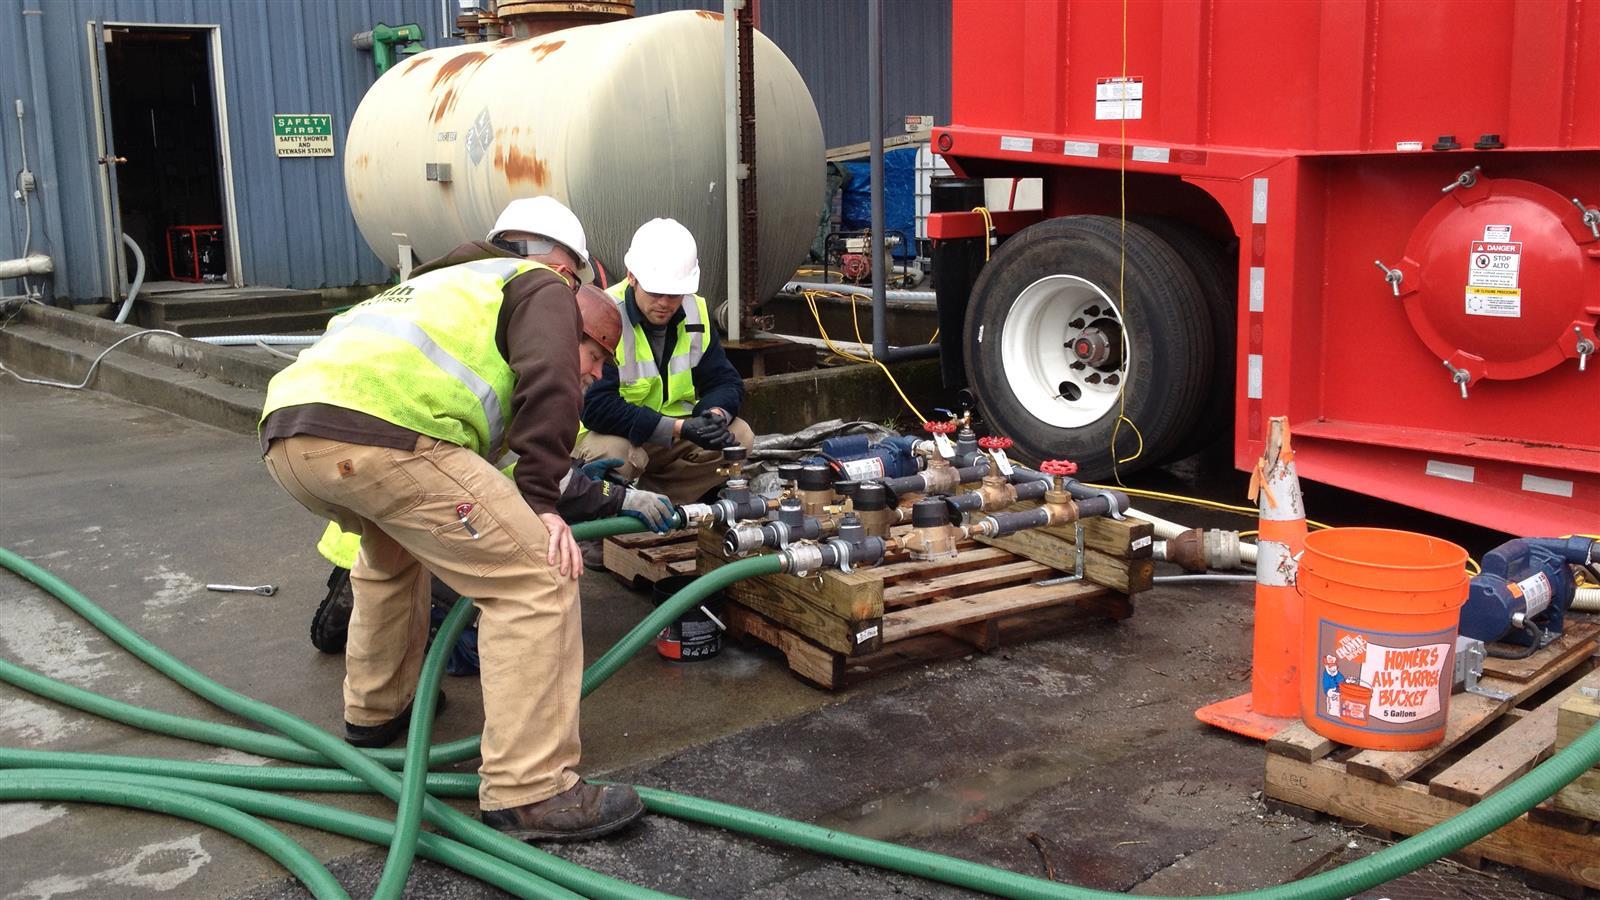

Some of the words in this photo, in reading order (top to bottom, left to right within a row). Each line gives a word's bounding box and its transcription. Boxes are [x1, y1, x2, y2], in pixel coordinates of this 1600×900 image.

[278, 118, 327, 127] SAFETY
[285, 126, 322, 134] FIRST
[1486, 244, 1516, 252] DANGER
[1335, 635, 1366, 659] HOME
[1379, 688, 1428, 707] BUCKET
[1383, 709, 1389, 717] 5
[1390, 709, 1417, 717] Gallons
